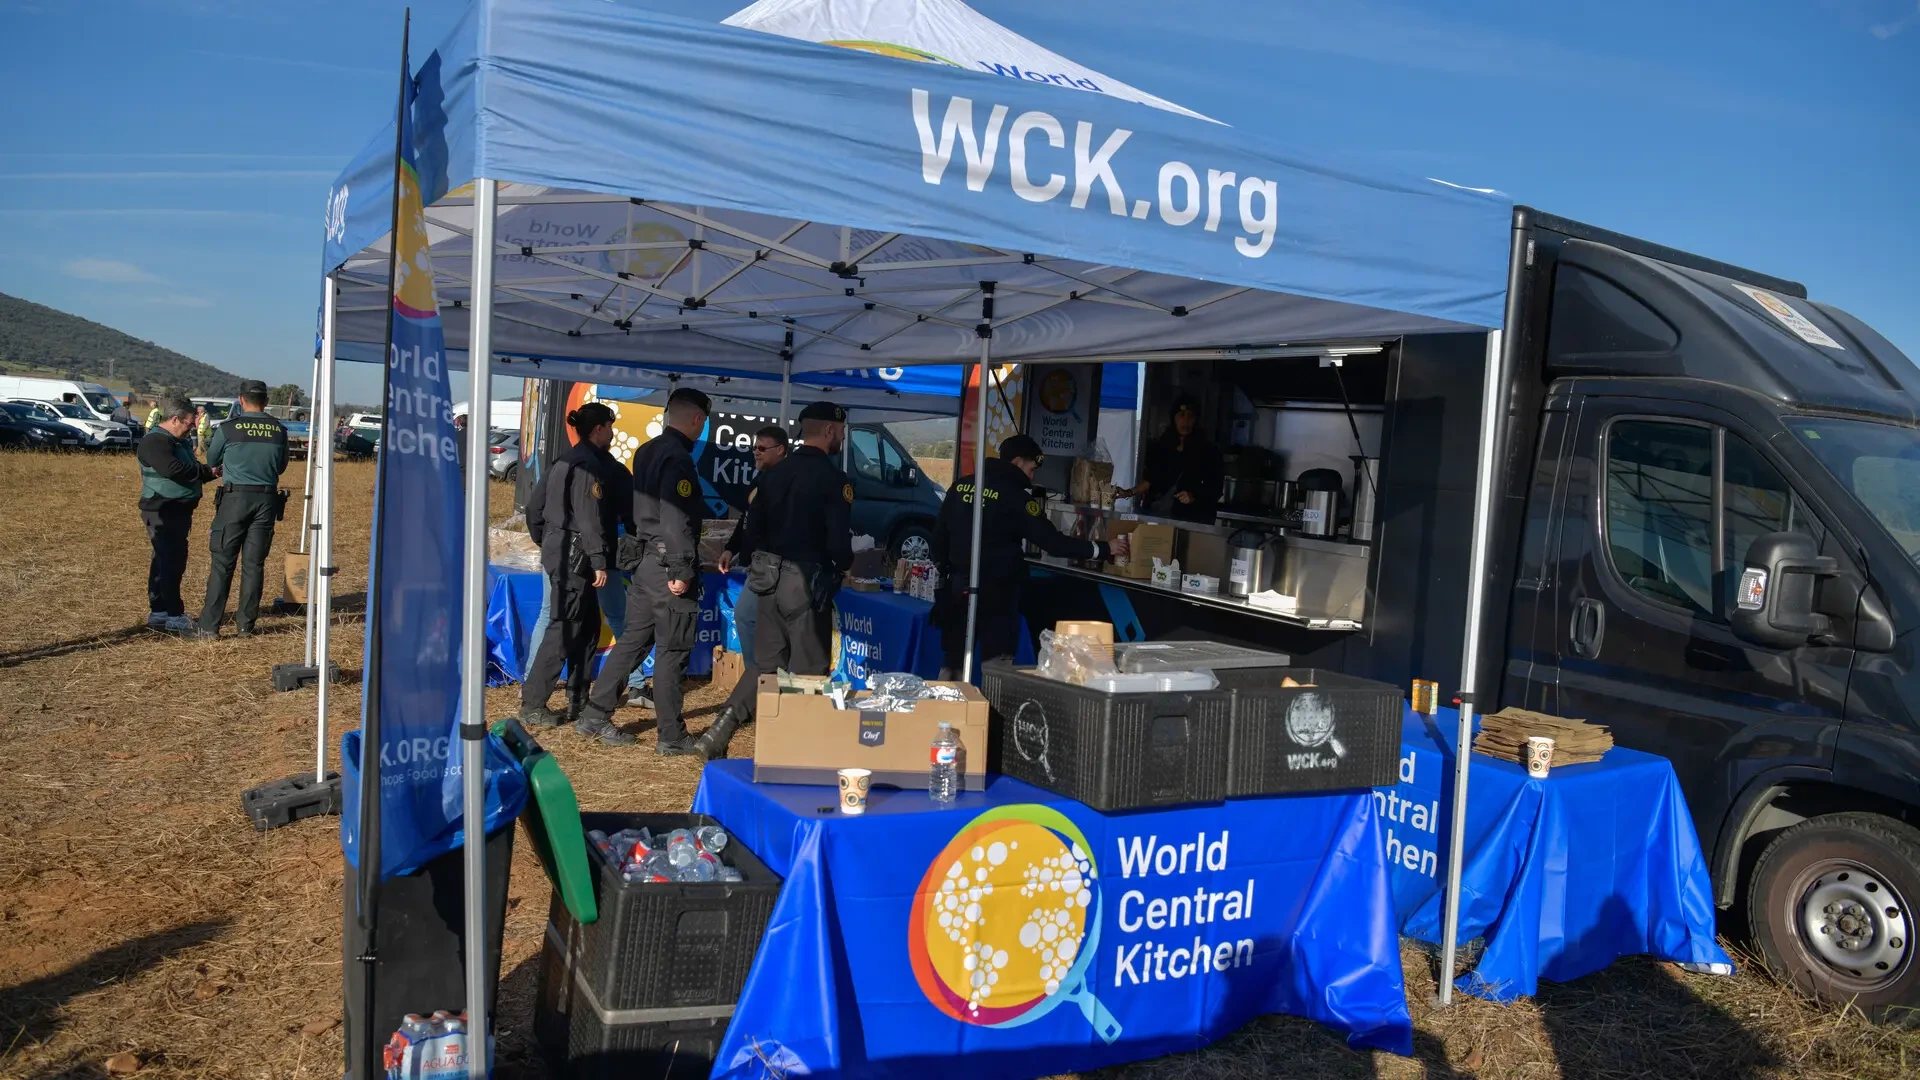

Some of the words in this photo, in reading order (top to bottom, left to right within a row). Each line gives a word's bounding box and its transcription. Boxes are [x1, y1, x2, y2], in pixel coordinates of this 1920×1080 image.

[977, 60, 1104, 92] World
[911, 88, 1278, 258] WCK.org
[389, 343, 441, 383] orld
[235, 422, 281, 433] GUARDIA
[247, 429, 272, 438] CIVIL
[1042, 415, 1068, 427] World
[1042, 427, 1074, 438] Central
[1041, 438, 1075, 450] Kitchen
[956, 484, 999, 500] GUADIA
[844, 611, 873, 636] World
[845, 634, 882, 661] Central
[862, 730, 881, 742] Chef
[380, 736, 450, 768] K.ORG
[1373, 789, 1439, 834] ntral
[1117, 830, 1229, 879] World
[1118, 879, 1255, 933] Central
[1114, 936, 1255, 987] Kitchen
